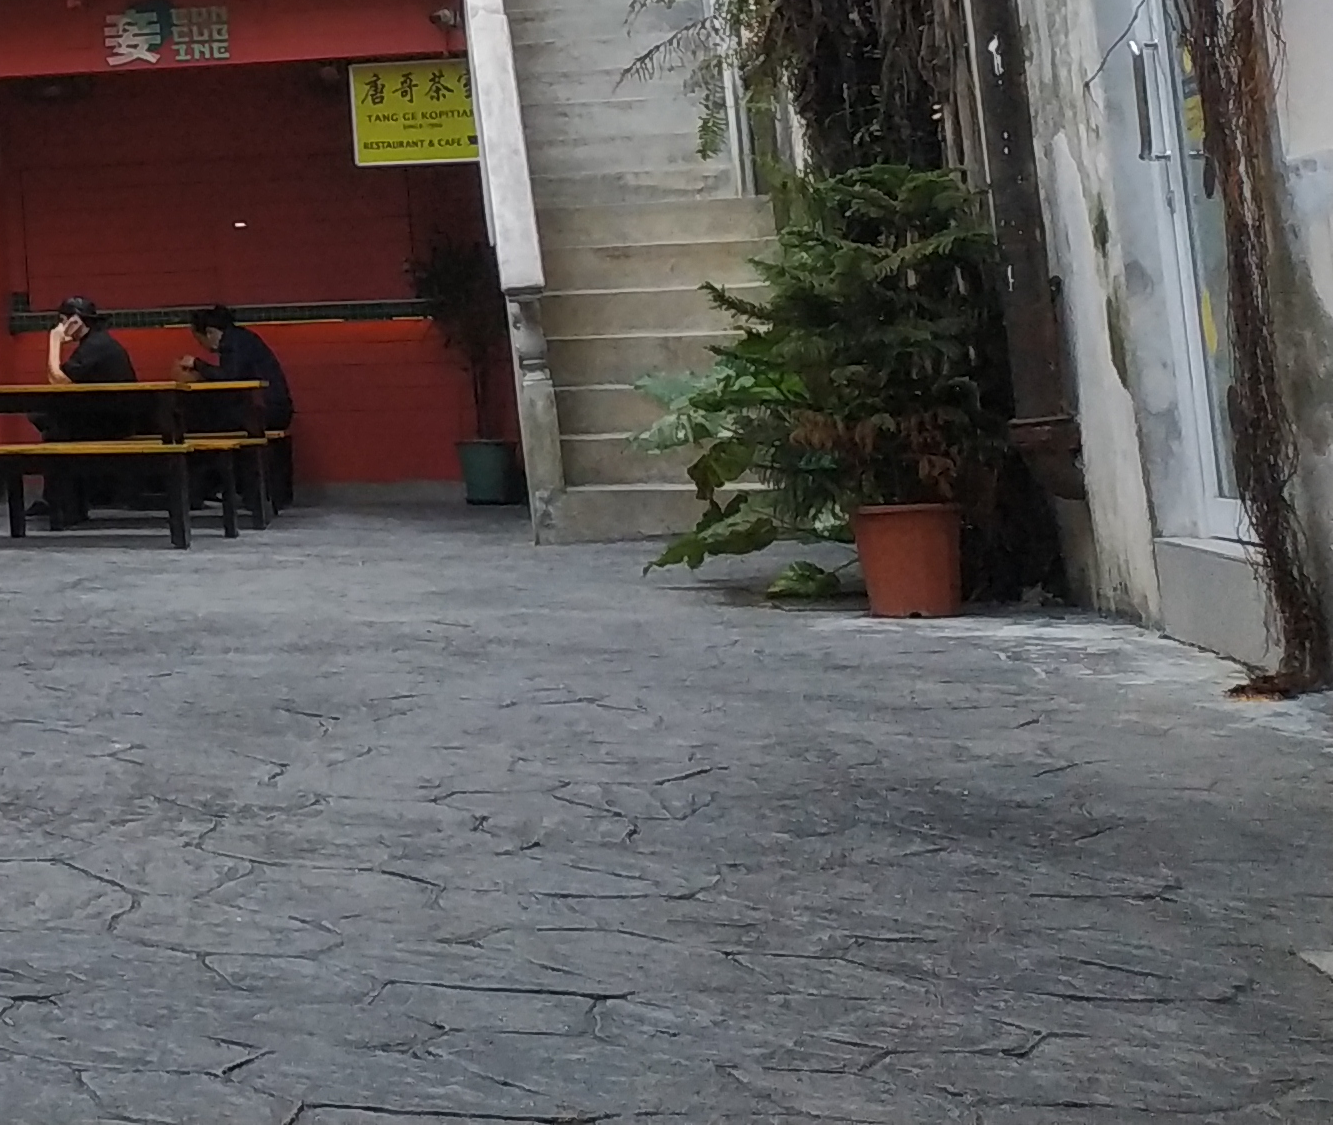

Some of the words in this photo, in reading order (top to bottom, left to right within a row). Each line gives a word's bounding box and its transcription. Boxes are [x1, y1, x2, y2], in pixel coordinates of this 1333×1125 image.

[171, 42, 231, 61] INE
[366, 113, 399, 123] TANG
[402, 111, 417, 121] GE
[363, 139, 425, 150] RESTAURANT
[428, 139, 435, 147] &
[437, 137, 462, 147] CAFE
